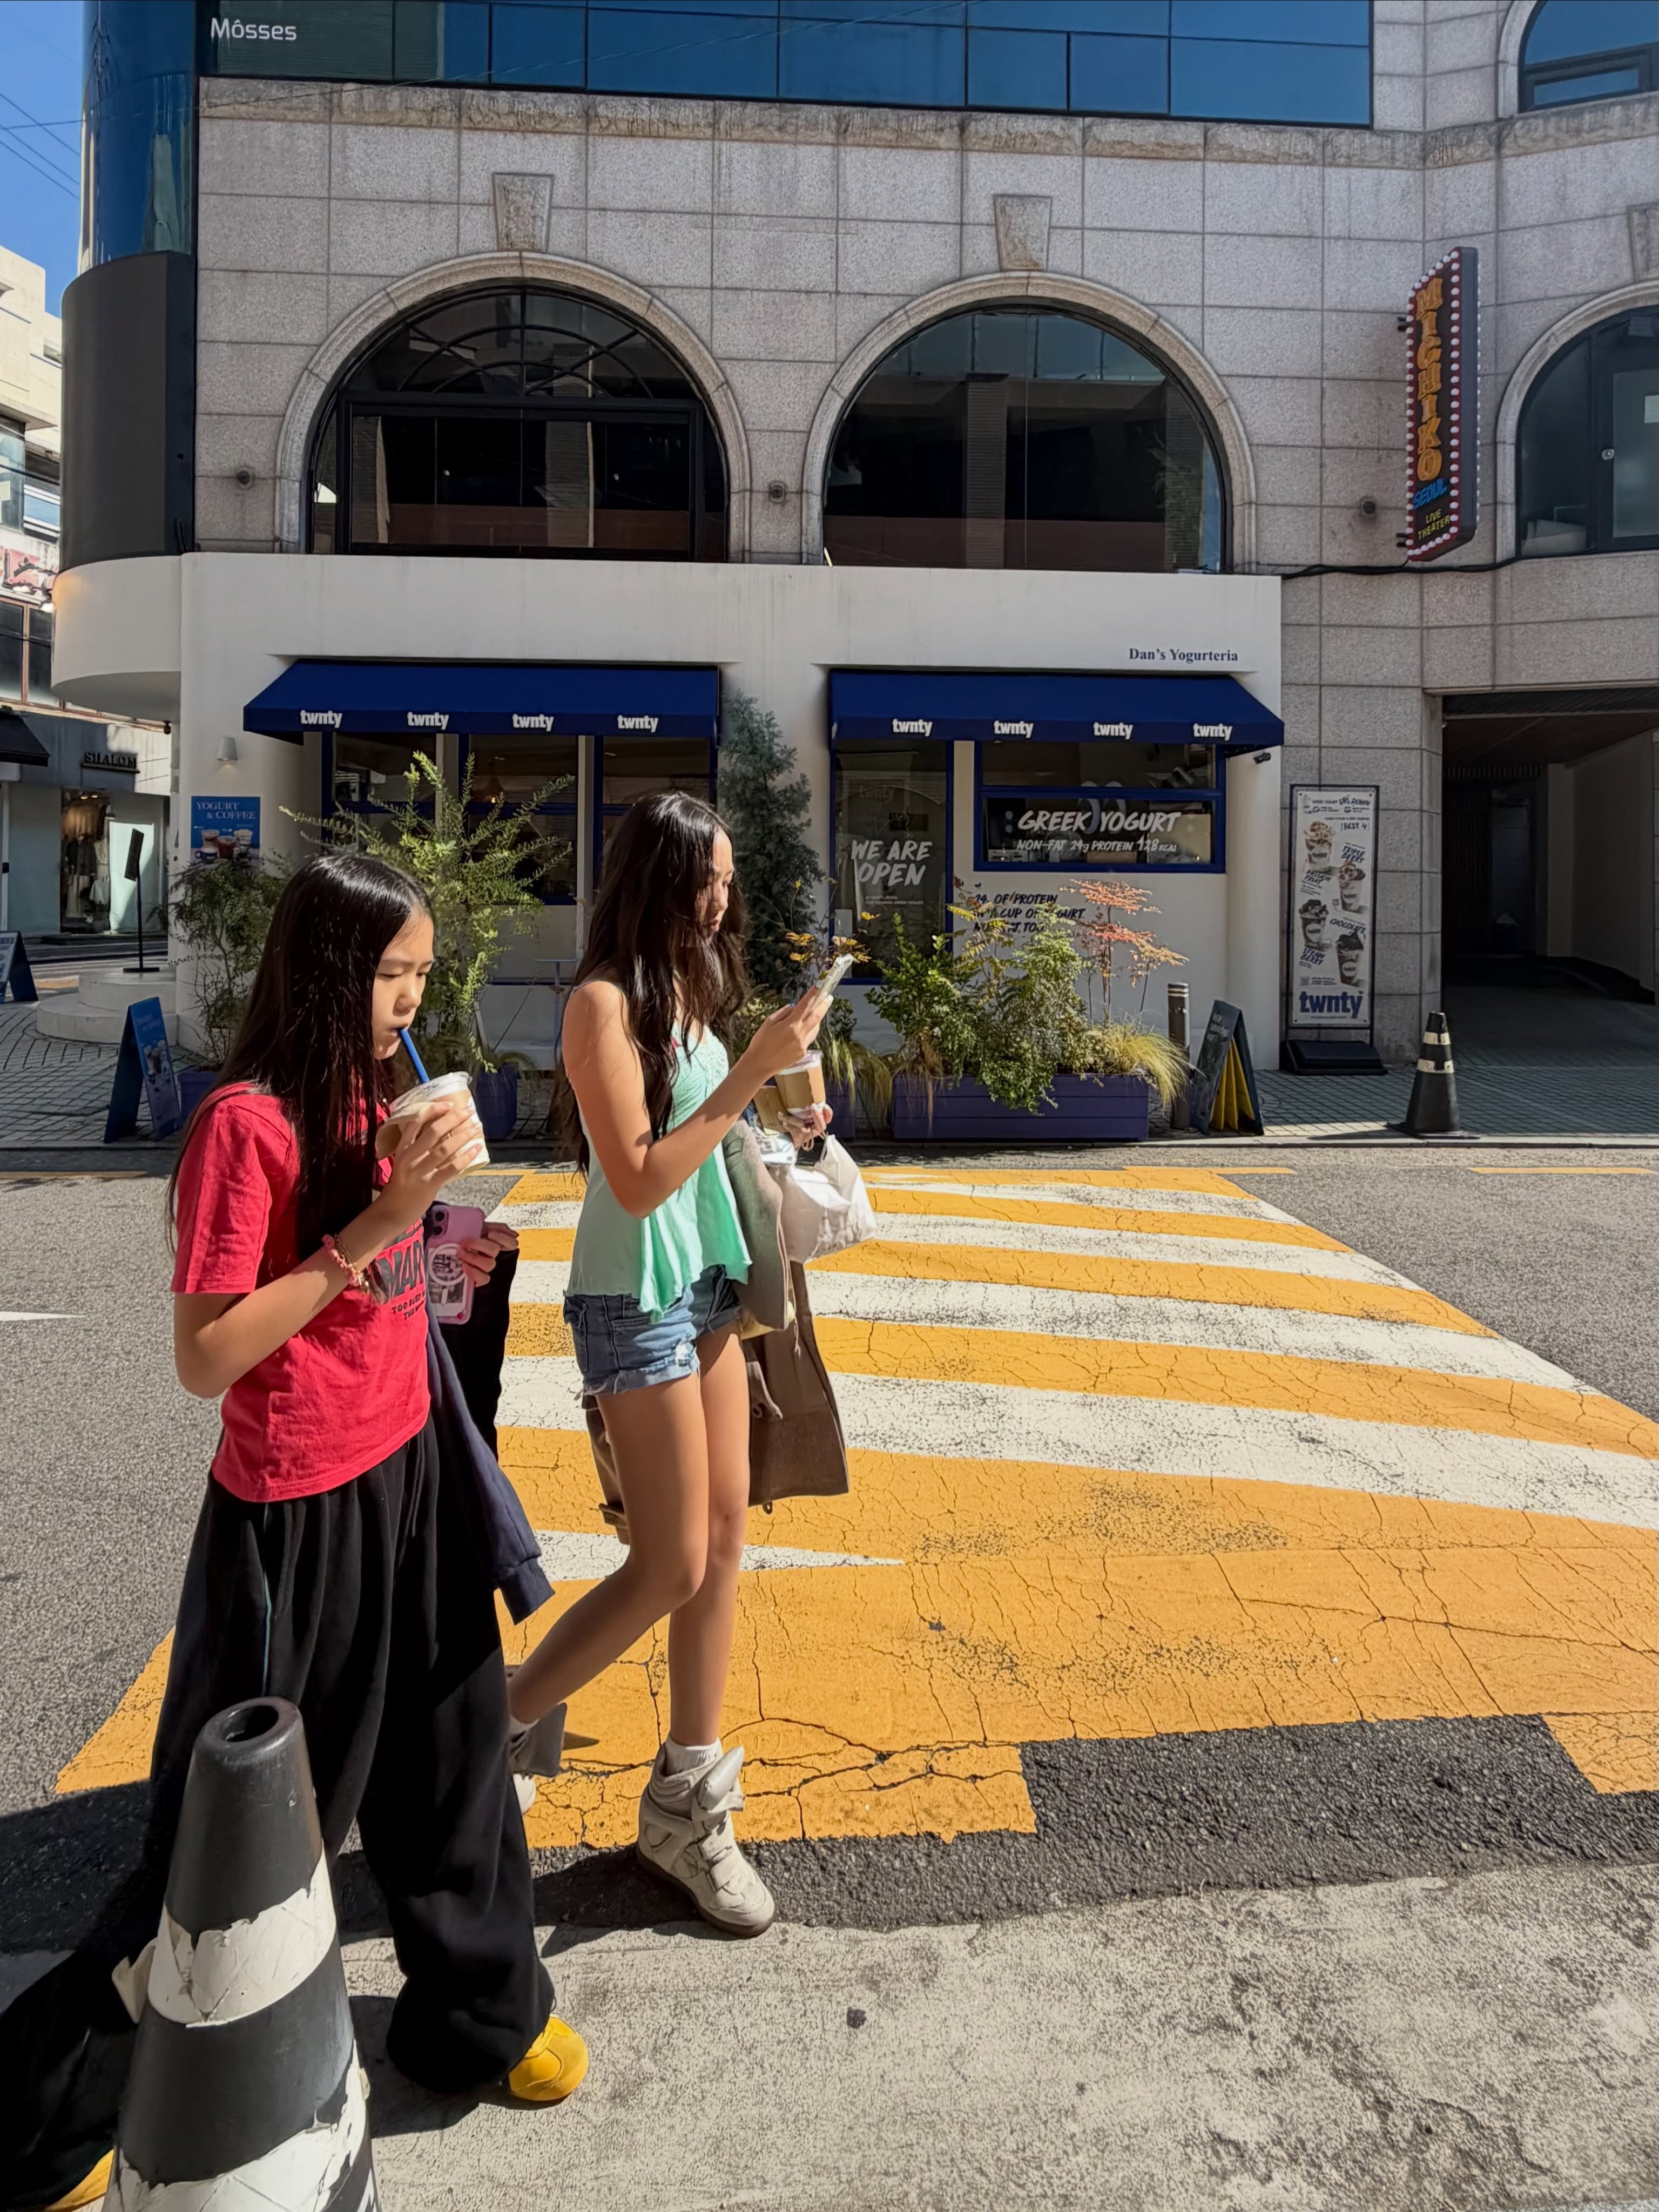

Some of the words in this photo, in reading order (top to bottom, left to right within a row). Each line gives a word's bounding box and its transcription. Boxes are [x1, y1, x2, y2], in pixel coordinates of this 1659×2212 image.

[211, 17, 297, 41] Môsses
[1416, 278, 1443, 482] MICHIKO
[1413, 478, 1447, 510] SEOUL
[1425, 508, 1442, 524] LIVE
[1417, 515, 1450, 539] THEATER
[1169, 649, 1238, 664] Yogurteria
[301, 711, 342, 727] twnty
[408, 712, 448, 729] twnty
[513, 714, 554, 731] twnty
[618, 716, 658, 732] twnty
[893, 719, 932, 736] twnty
[994, 721, 1033, 738] twnty
[1094, 723, 1132, 739] twnty
[1193, 724, 1232, 740] twnty
[85, 751, 137, 769] SHALOM
[197, 802, 239, 810] YOGURT
[216, 811, 255, 819] COFFEE
[1017, 810, 1091, 832] GREEK
[1100, 811, 1181, 832] YOGURT
[851, 840, 884, 860] WE
[887, 840, 933, 861] ARE
[1016, 839, 1068, 851] NON-FAT
[1070, 839, 1089, 853] 24g
[1091, 840, 1134, 851] PROTEIN
[1136, 833, 1157, 852] 128
[1158, 843, 1176, 852] KCAL
[858, 862, 926, 886] OPEN
[994, 894, 1009, 904] OF
[1013, 893, 1058, 905] PROTEIN
[1000, 908, 1022, 918] CUP
[1299, 991, 1363, 1019] twnty
